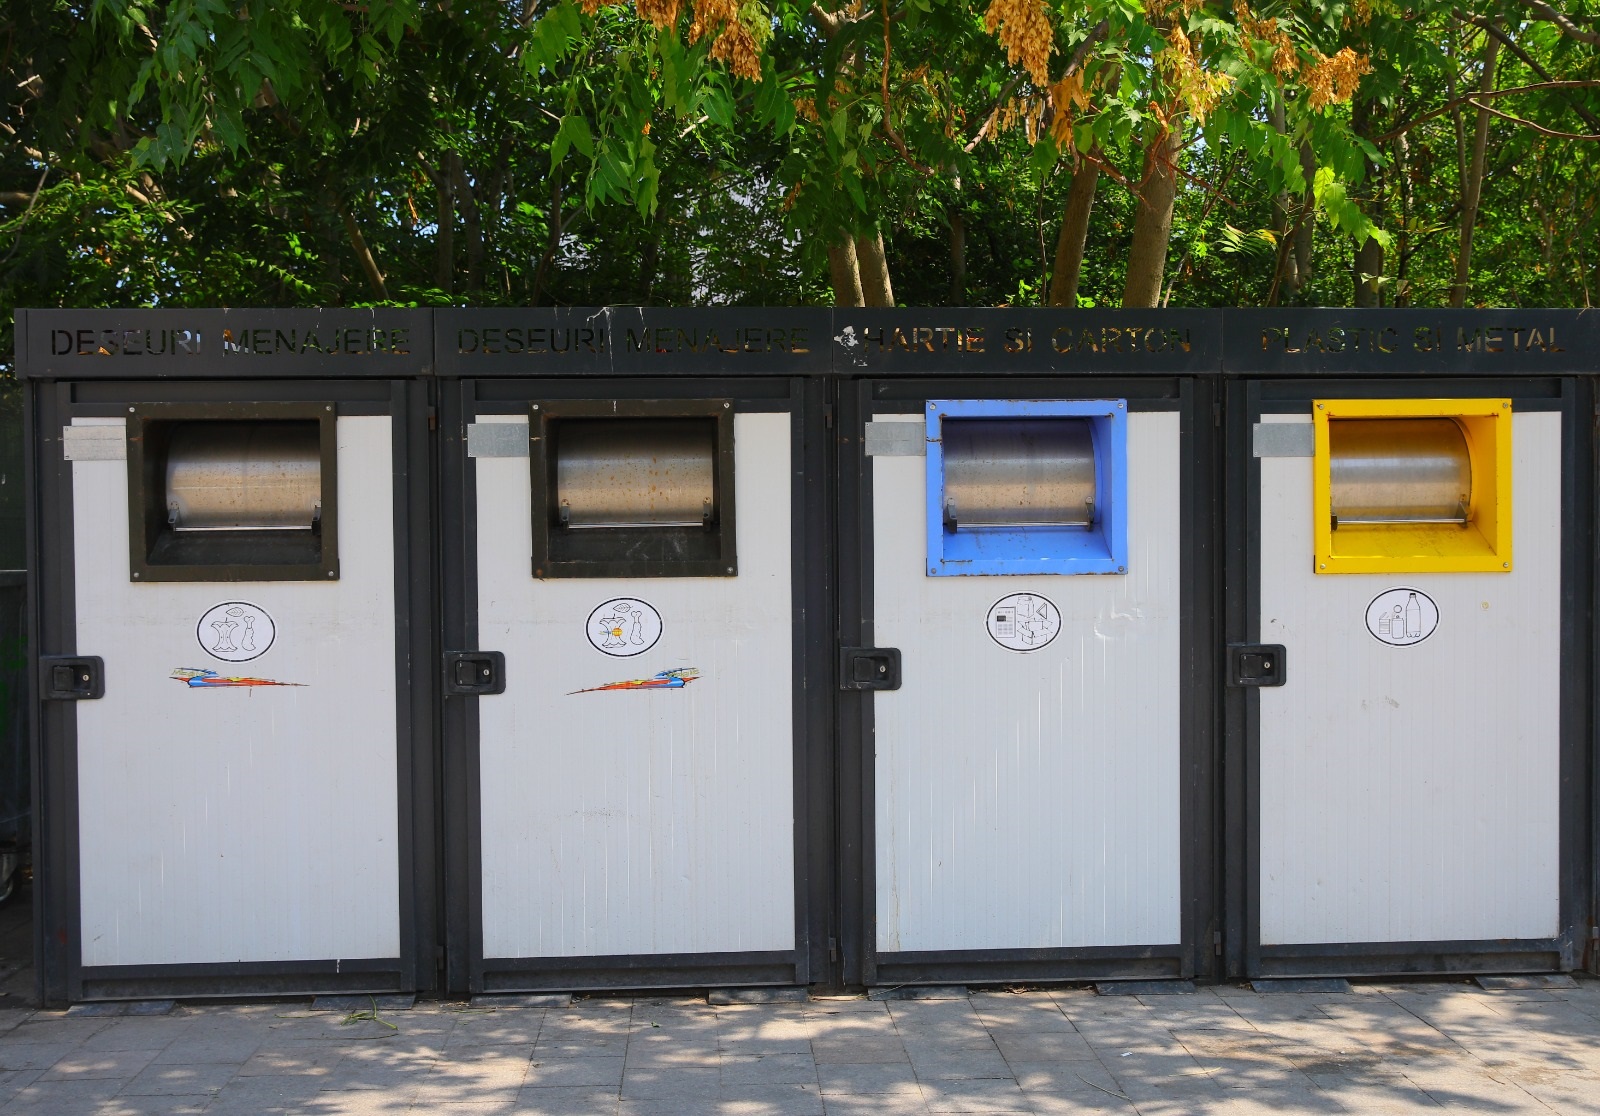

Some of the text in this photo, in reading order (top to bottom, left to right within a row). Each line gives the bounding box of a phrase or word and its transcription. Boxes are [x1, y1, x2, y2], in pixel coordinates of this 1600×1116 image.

[51, 328, 411, 356] DESEURI MENAJERE
[458, 328, 811, 354] DESEURI MENAJERE
[863, 327, 1191, 353] HARTIE SI CARTON
[1260, 327, 1566, 354] PLASTIC SI METAL
